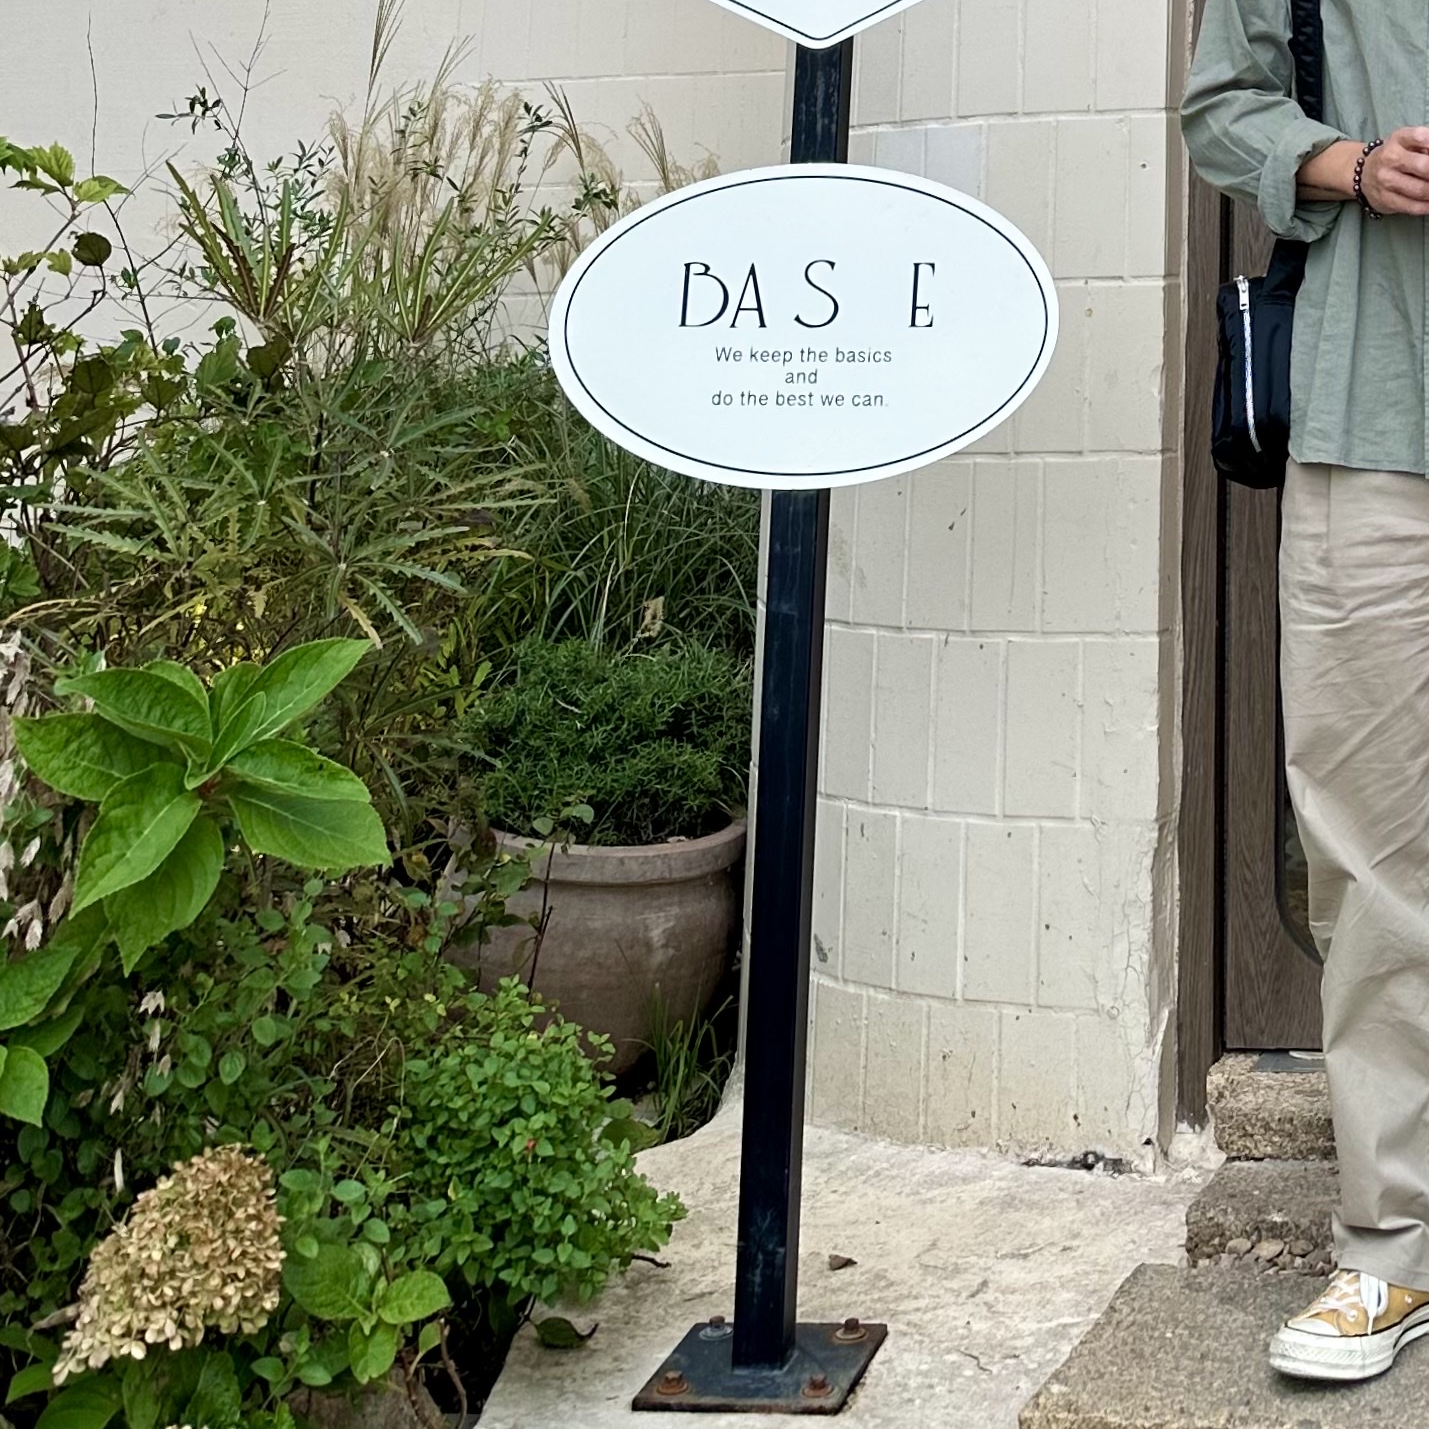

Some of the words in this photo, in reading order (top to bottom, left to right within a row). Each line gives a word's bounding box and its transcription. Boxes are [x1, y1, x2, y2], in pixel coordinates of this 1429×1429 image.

[715, 346, 743, 363] We
[749, 346, 793, 367] keep
[799, 346, 829, 363] the
[835, 346, 892, 363] basics
[784, 368, 818, 385] and
[711, 389, 734, 407] do
[740, 390, 769, 407] the
[775, 390, 815, 407] best
[820, 394, 845, 407] we
